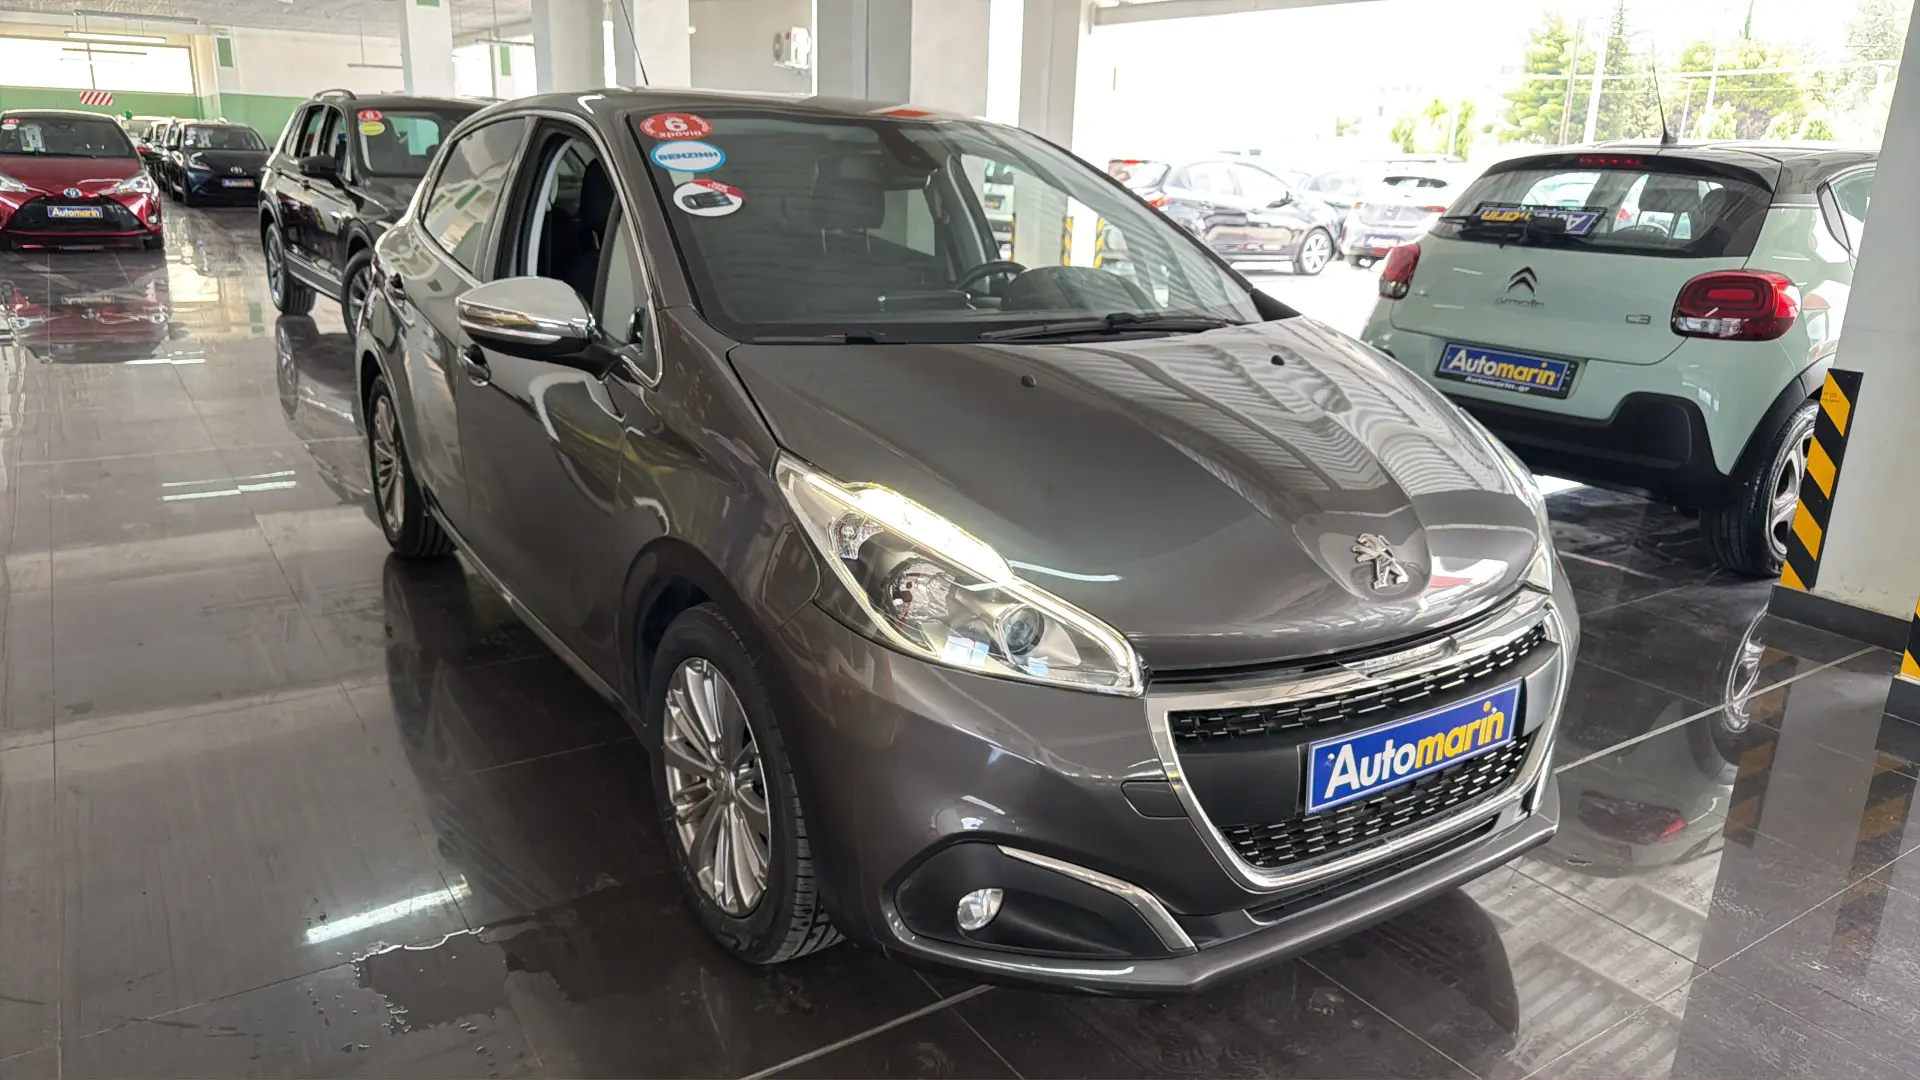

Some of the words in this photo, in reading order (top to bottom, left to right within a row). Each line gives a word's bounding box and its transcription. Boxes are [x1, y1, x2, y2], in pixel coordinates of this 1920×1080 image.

[664, 116, 688, 132] 6
[52, 207, 100, 217] Automarin
[1625, 313, 1652, 325] C3
[1448, 349, 1556, 386] Automarin
[1464, 376, 1530, 392] Automarin.gr
[1324, 700, 1505, 800] Automarin
